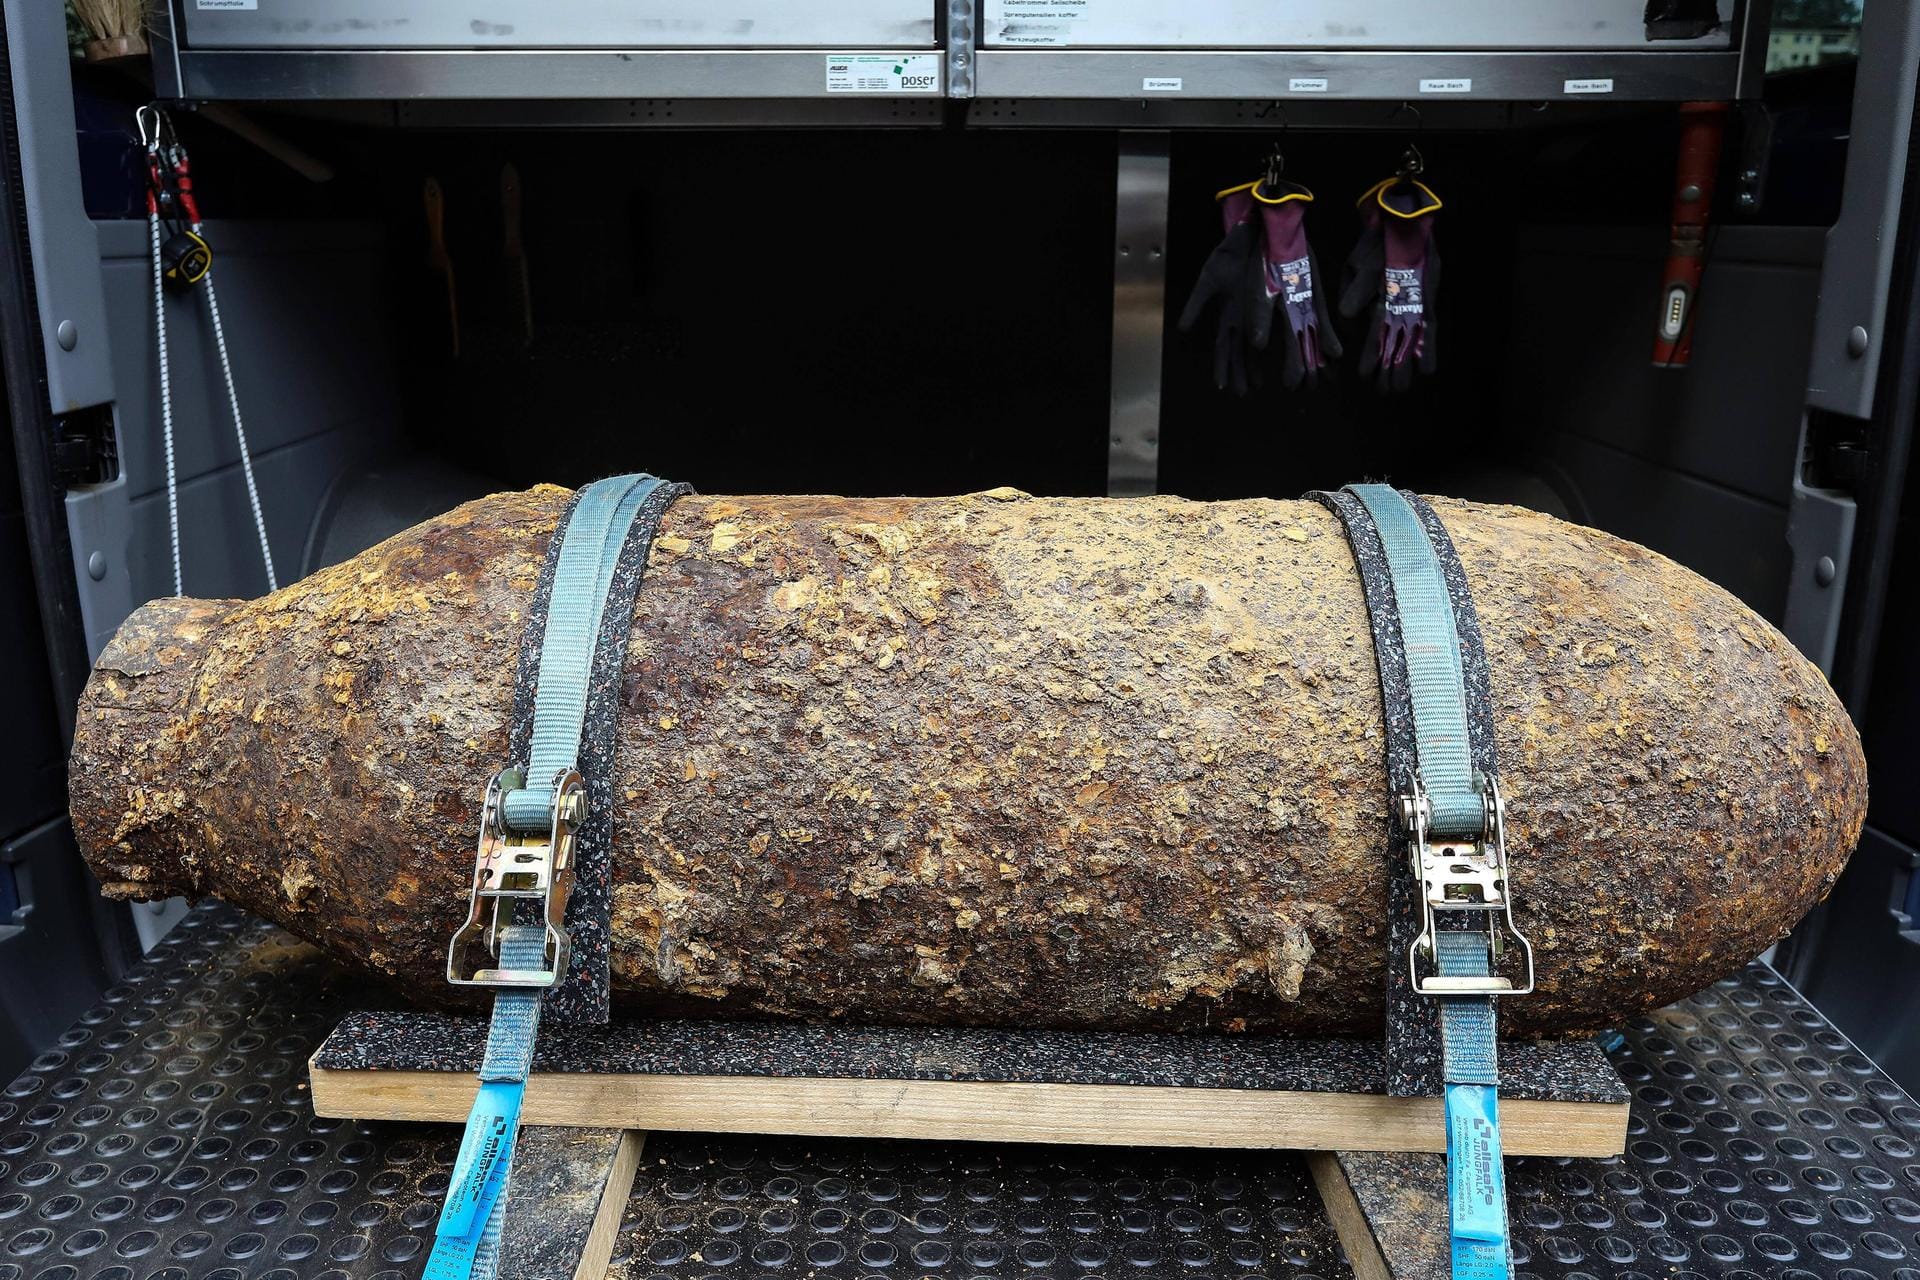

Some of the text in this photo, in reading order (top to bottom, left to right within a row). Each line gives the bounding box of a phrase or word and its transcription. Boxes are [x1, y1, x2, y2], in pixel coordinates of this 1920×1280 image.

[902, 75, 936, 88] poser
[1385, 301, 1423, 315] MaxiDry
[470, 1136, 492, 1192] JUNGFALK
[1473, 1138, 1484, 1196] JUNGFALK
[1481, 1138, 1494, 1206] allsafe
